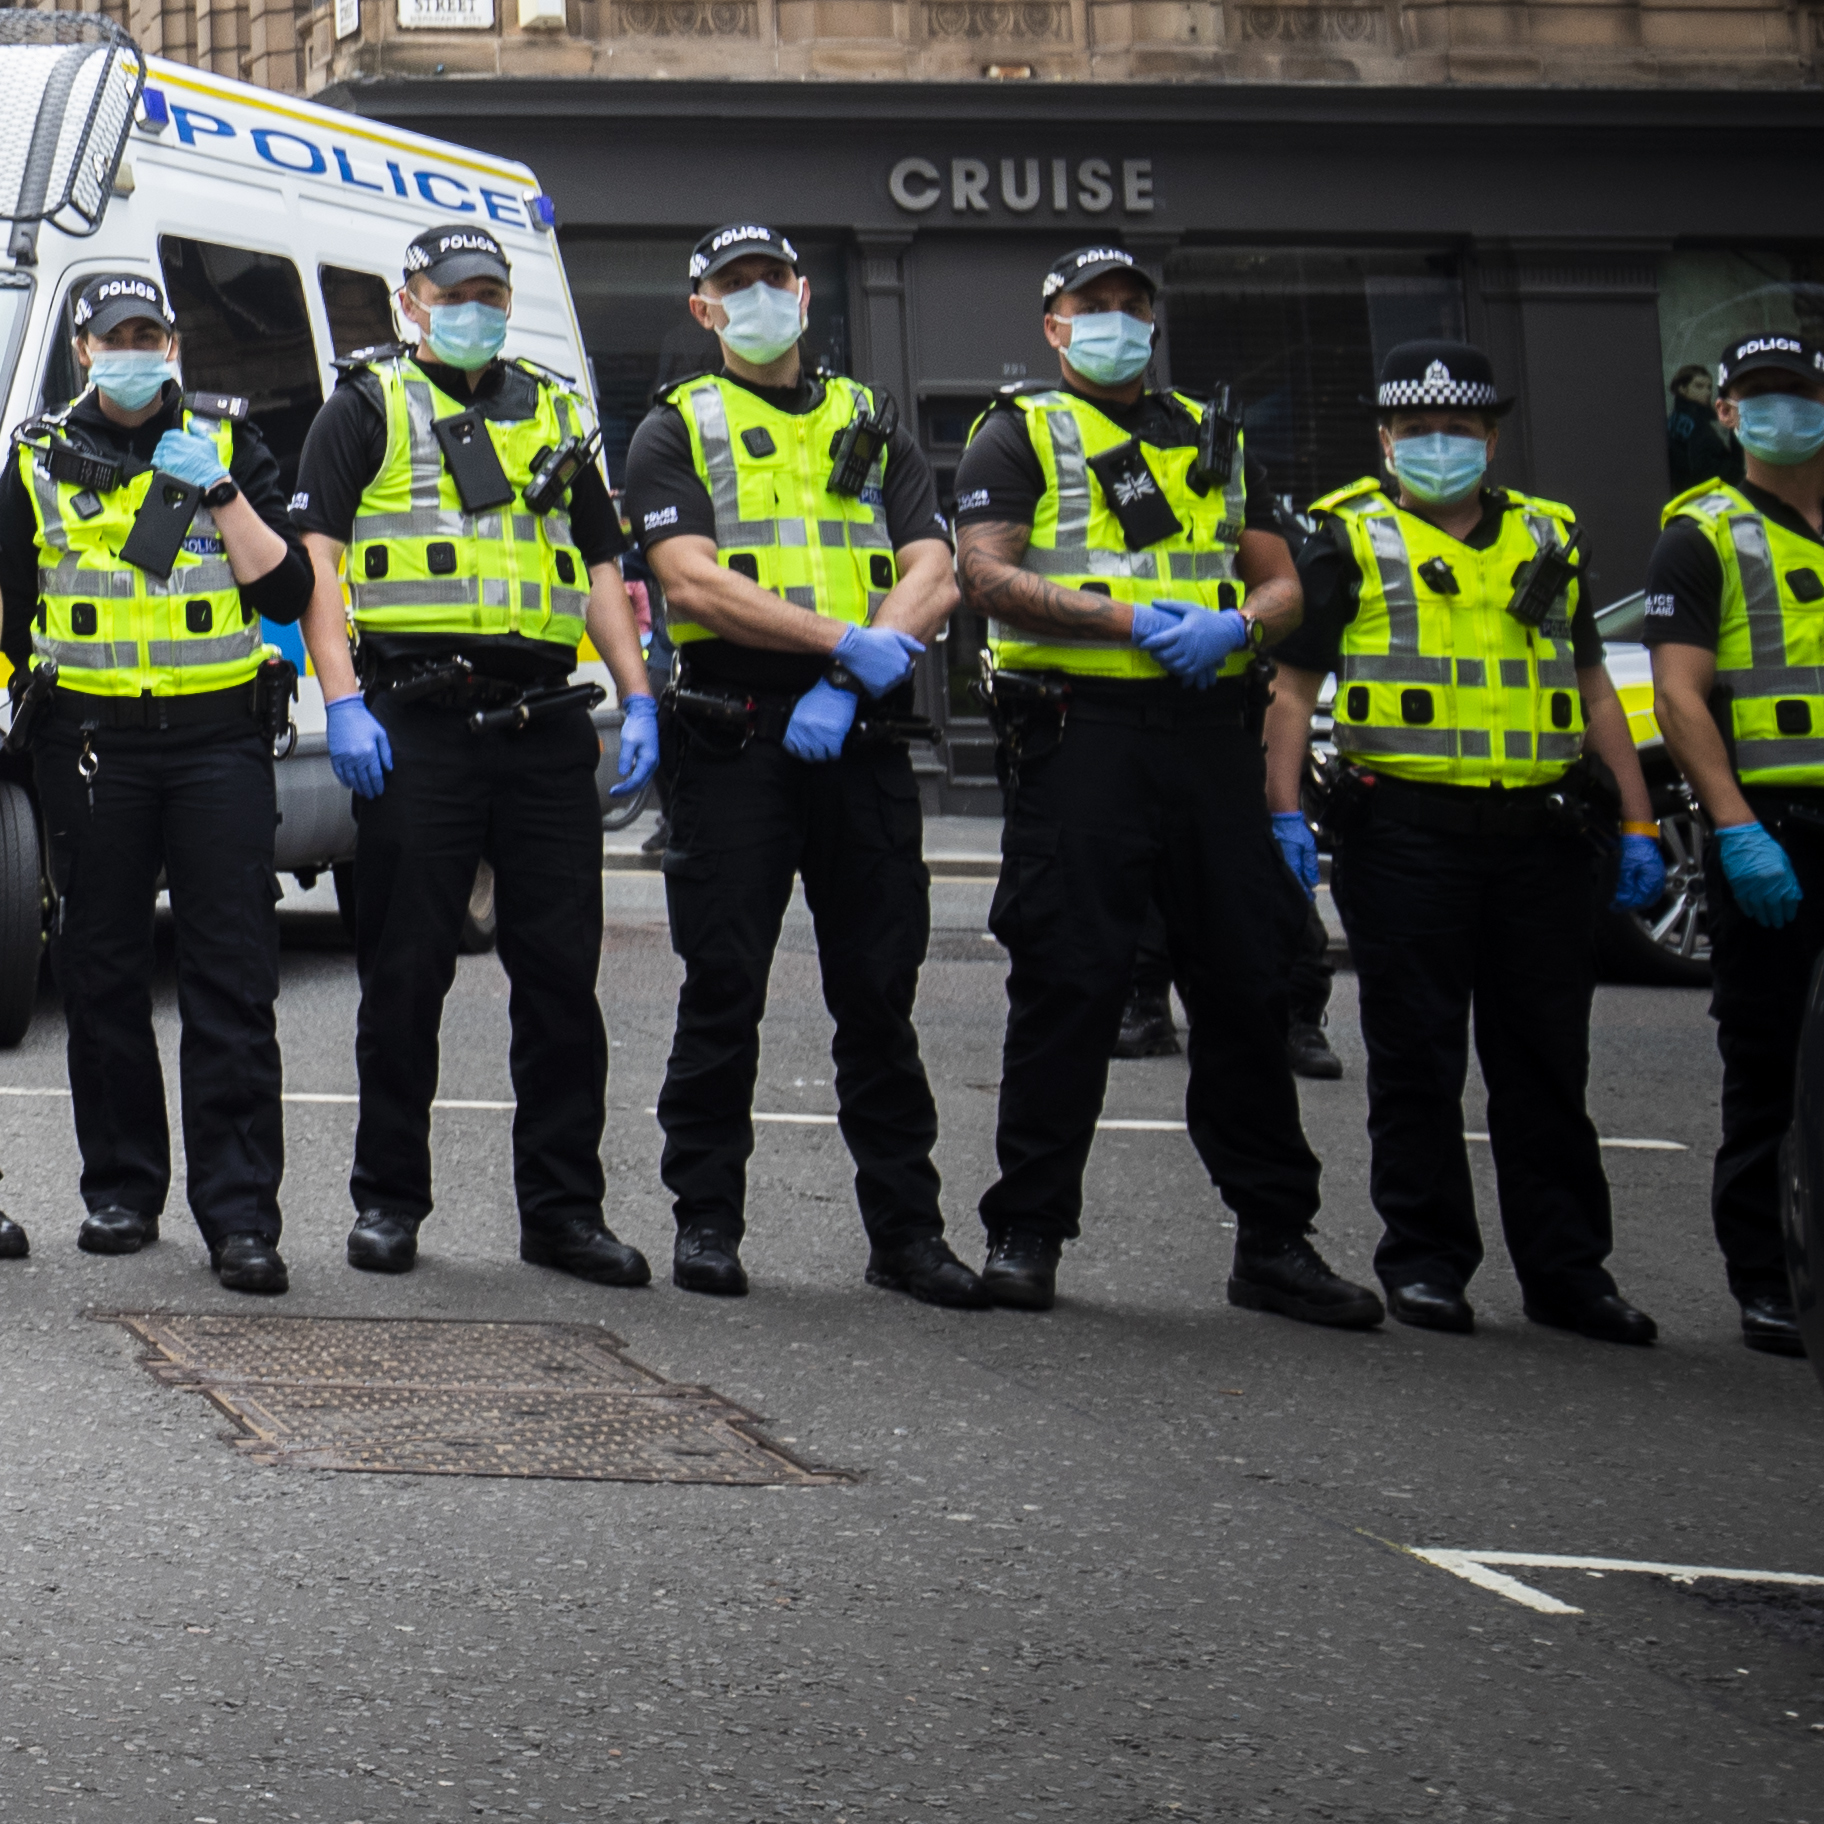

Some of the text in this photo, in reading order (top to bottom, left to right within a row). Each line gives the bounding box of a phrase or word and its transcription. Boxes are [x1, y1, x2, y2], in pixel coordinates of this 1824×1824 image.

[170, 104, 527, 229] POLICE
[889, 157, 1154, 212] CRUISE
[440, 234, 498, 254] POLICE
[713, 225, 771, 251] POLICE
[1077, 249, 1132, 268] POLICE
[97, 280, 155, 302] POLICE
[1738, 337, 1802, 360] POLICE
